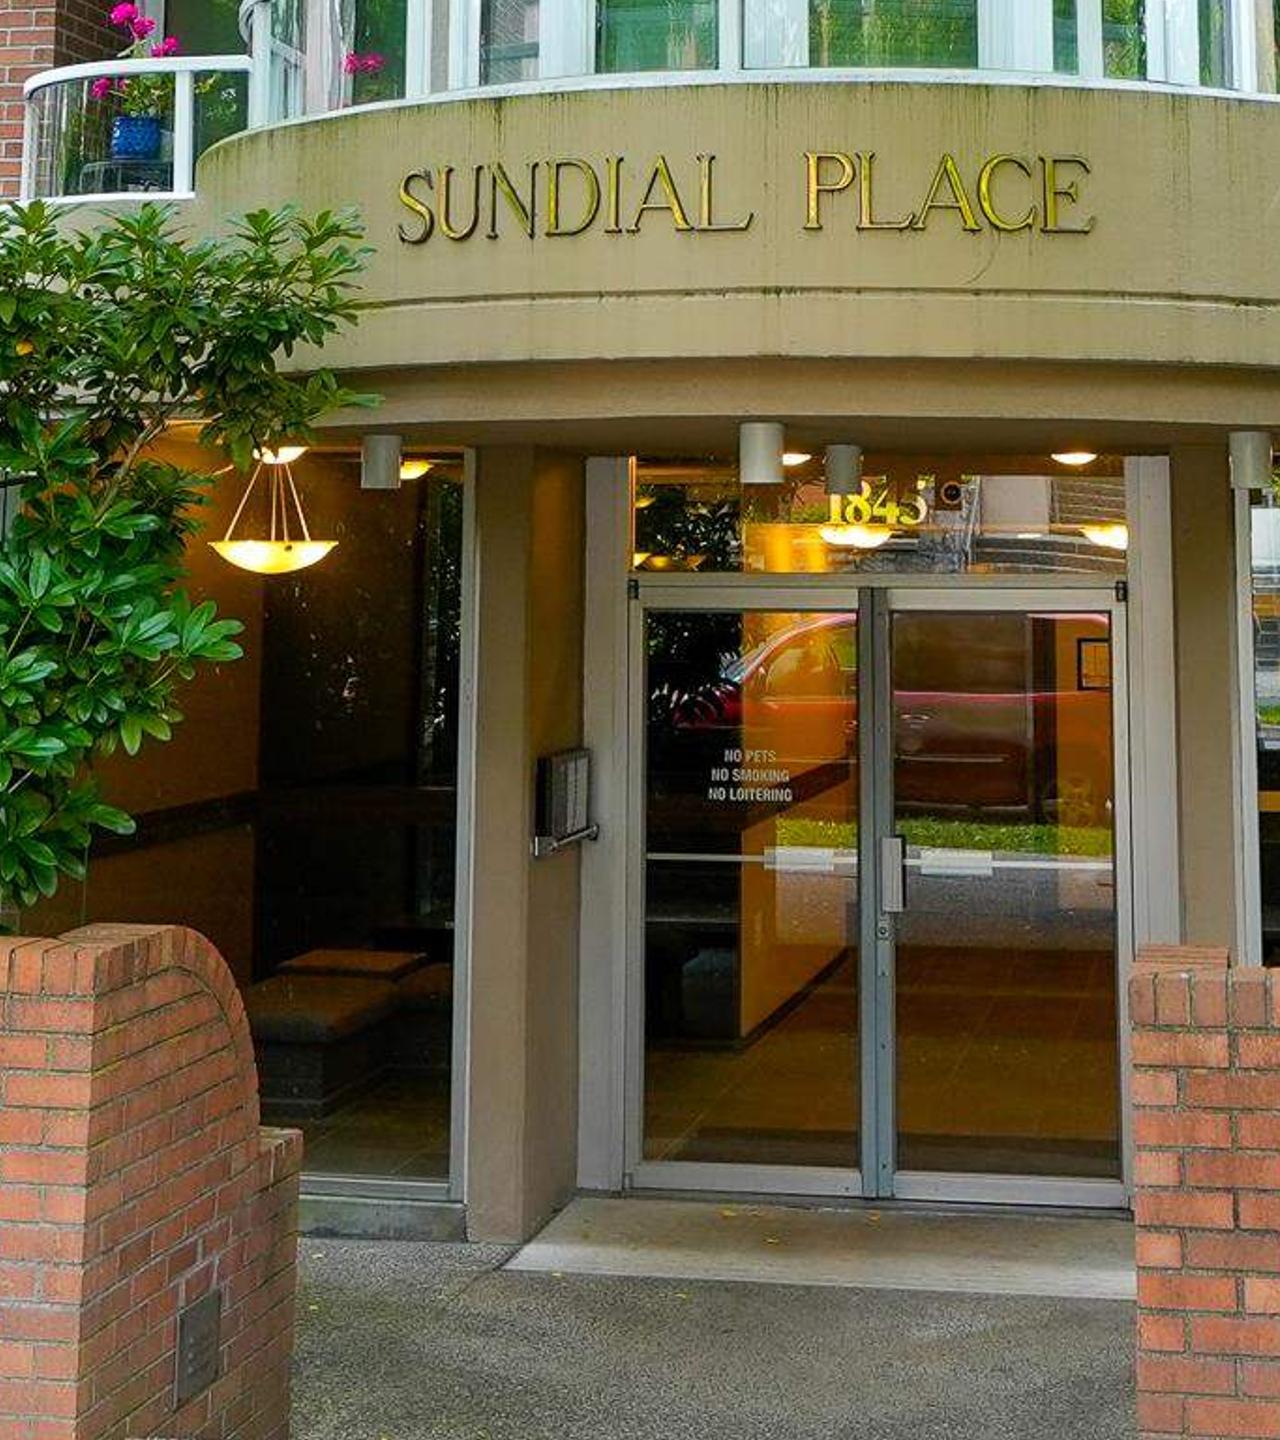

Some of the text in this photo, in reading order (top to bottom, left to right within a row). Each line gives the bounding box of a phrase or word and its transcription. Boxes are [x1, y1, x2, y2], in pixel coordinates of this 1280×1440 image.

[398, 151, 1097, 245] SUNDIAL PLACE
[824, 474, 928, 525] 1845
[724, 749, 776, 762] NO PETS
[711, 768, 790, 782] NO SMOKING
[708, 788, 793, 801] NO LOITERING
